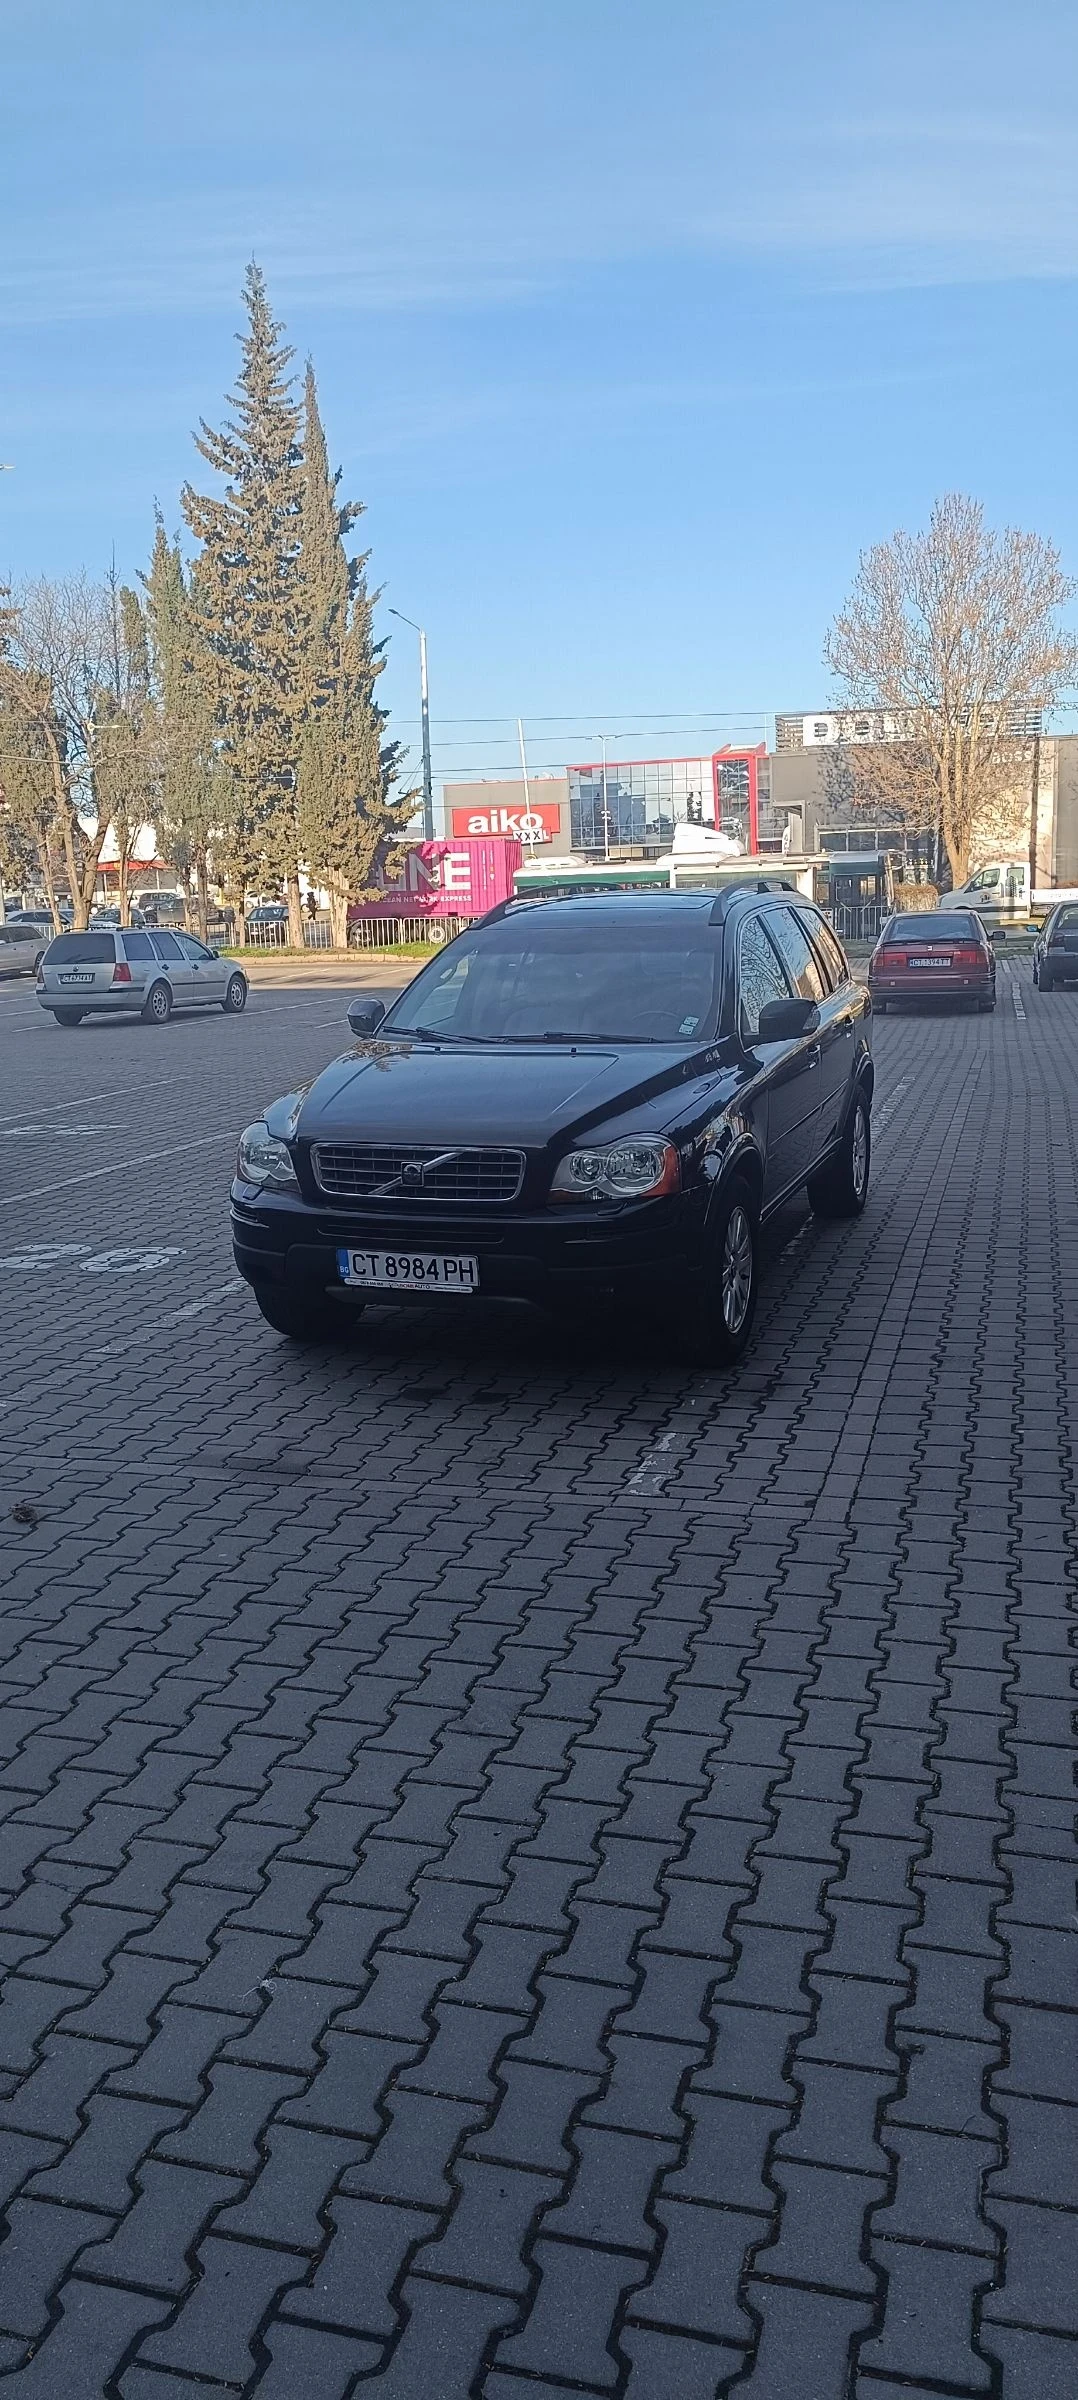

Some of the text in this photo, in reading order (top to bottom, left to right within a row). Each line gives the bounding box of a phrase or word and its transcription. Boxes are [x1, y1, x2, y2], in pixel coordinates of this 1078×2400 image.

[467, 809, 543, 834] aiko
[352, 1254, 474, 1282] CT 8984 PH
